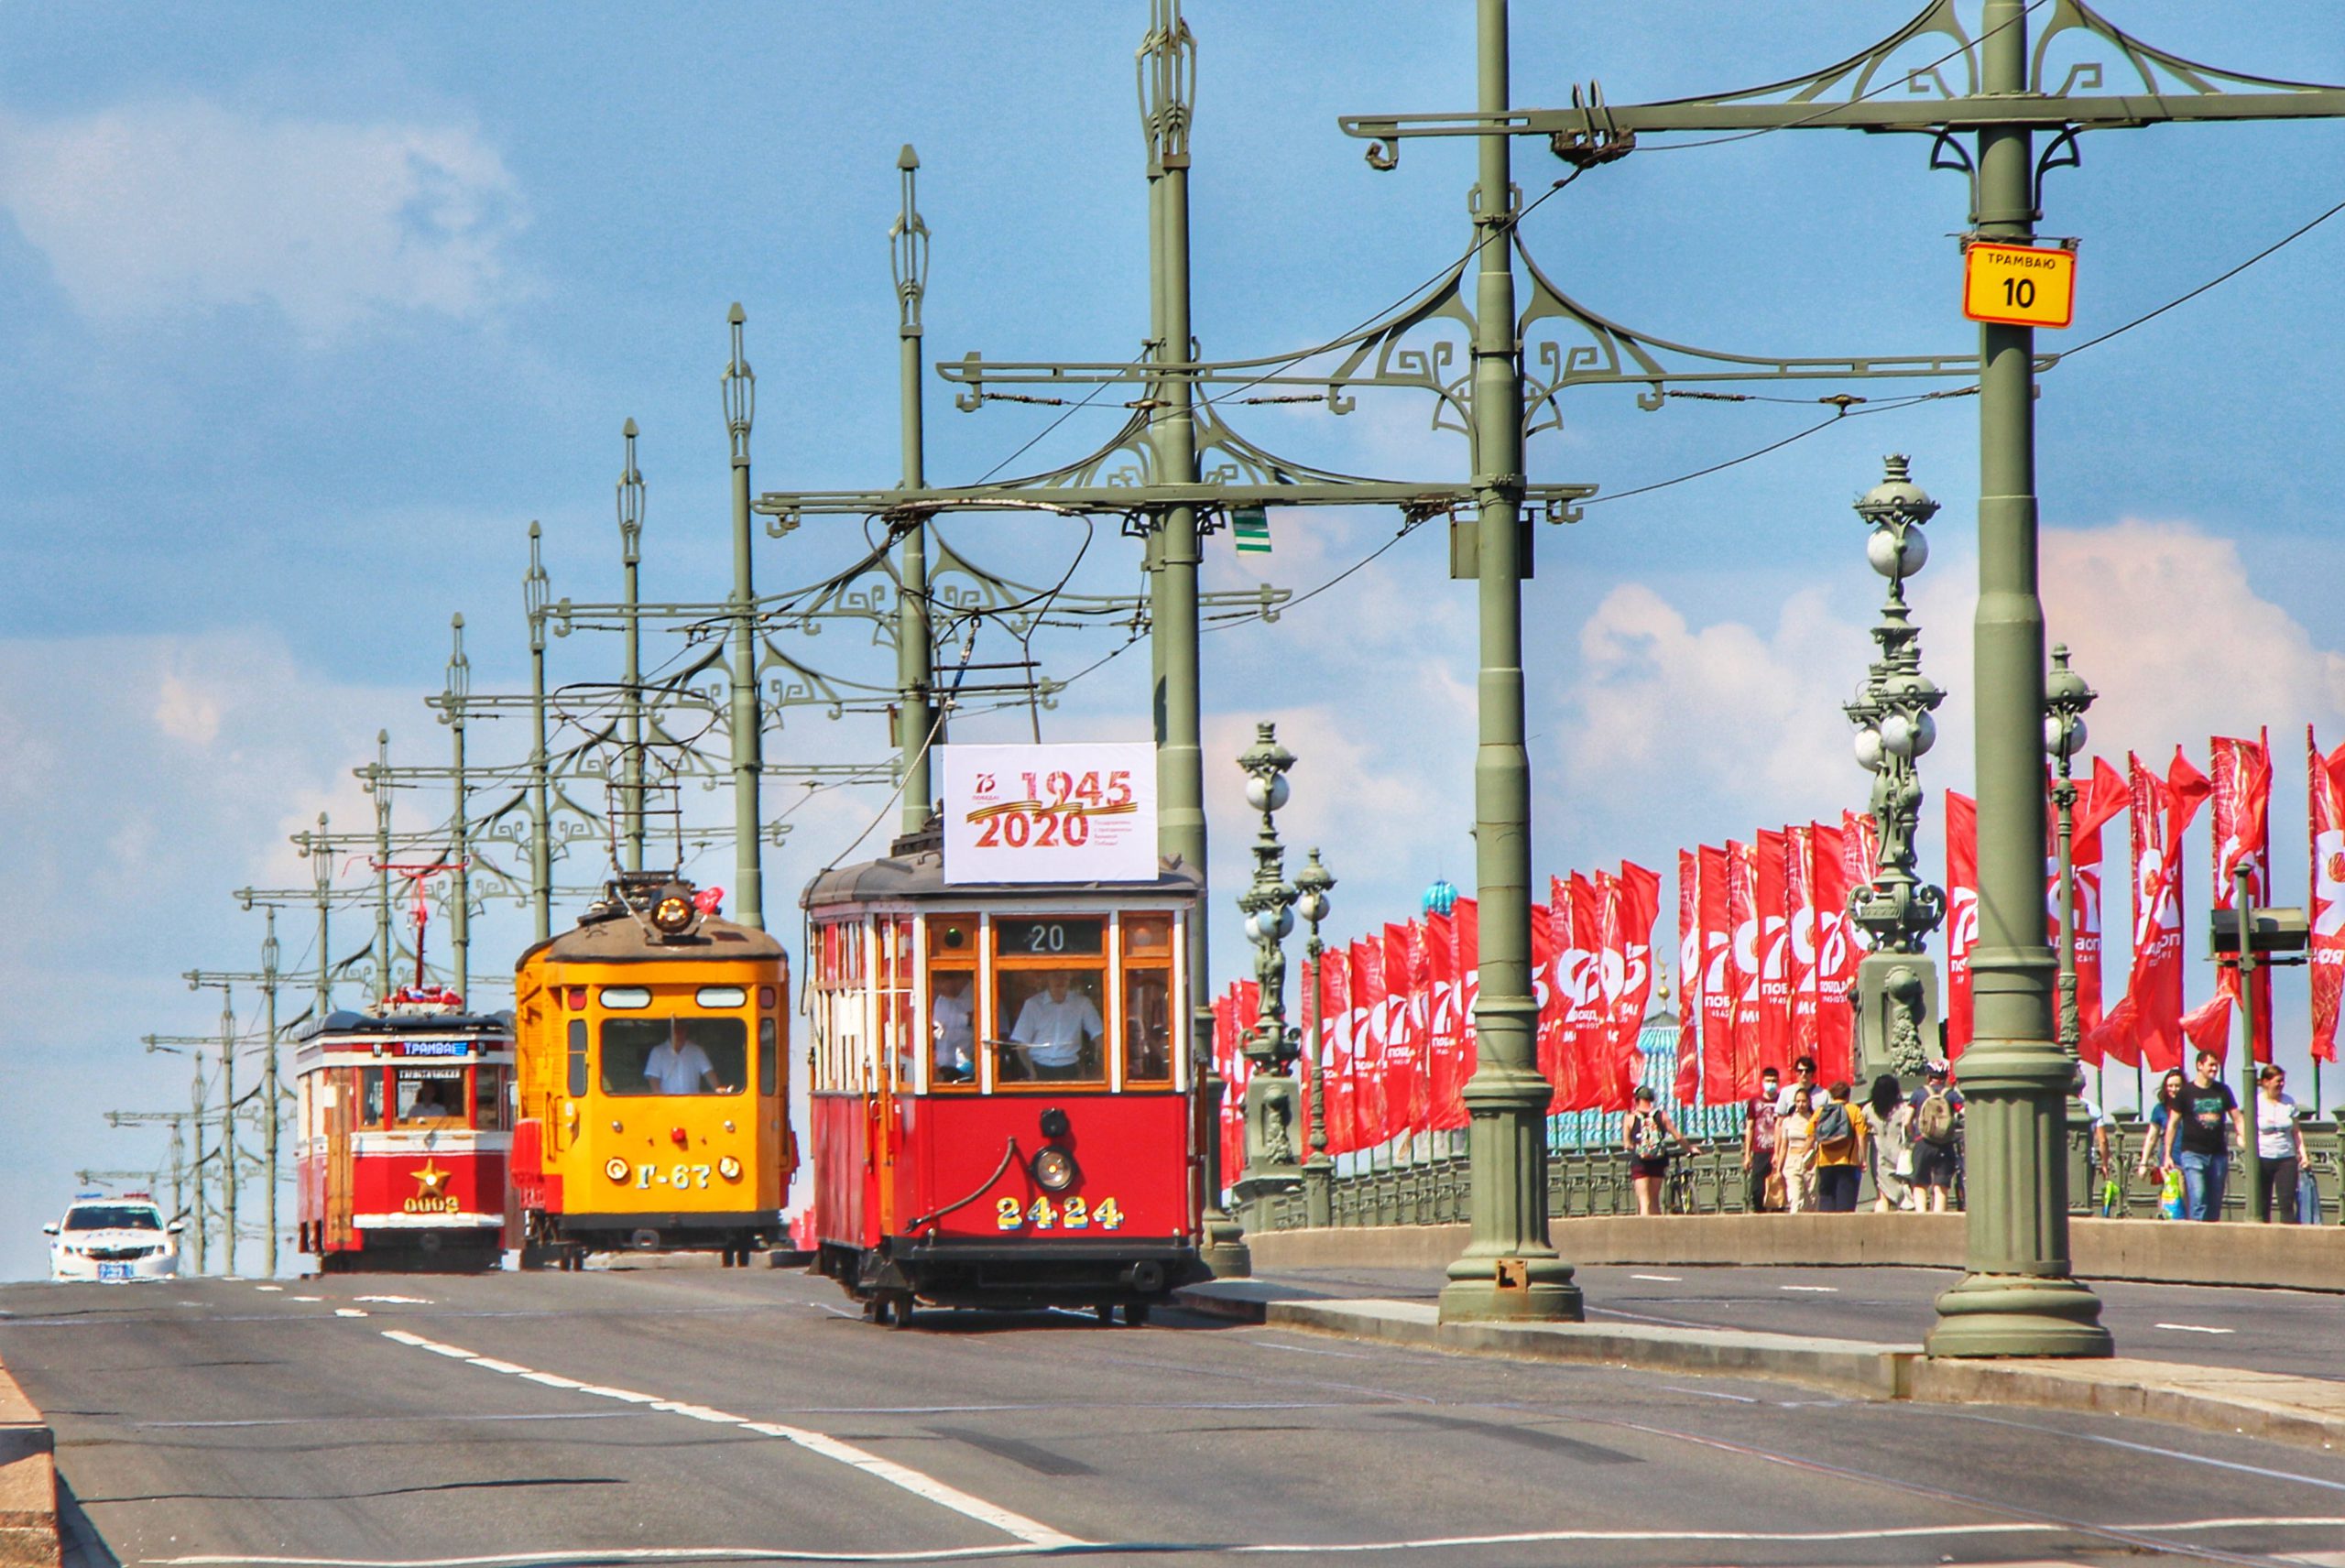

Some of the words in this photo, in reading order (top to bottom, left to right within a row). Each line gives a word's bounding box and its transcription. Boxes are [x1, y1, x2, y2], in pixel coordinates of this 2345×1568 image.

[1988, 253, 2056, 270] ТРАМВАЮ
[2003, 278, 2035, 309] 10
[1021, 771, 1131, 807] 1945
[975, 811, 1089, 848] 2020
[1031, 925, 1063, 951] 20
[404, 1042, 467, 1055] ТРАМВА
[997, 1196, 1125, 1230] 2424
